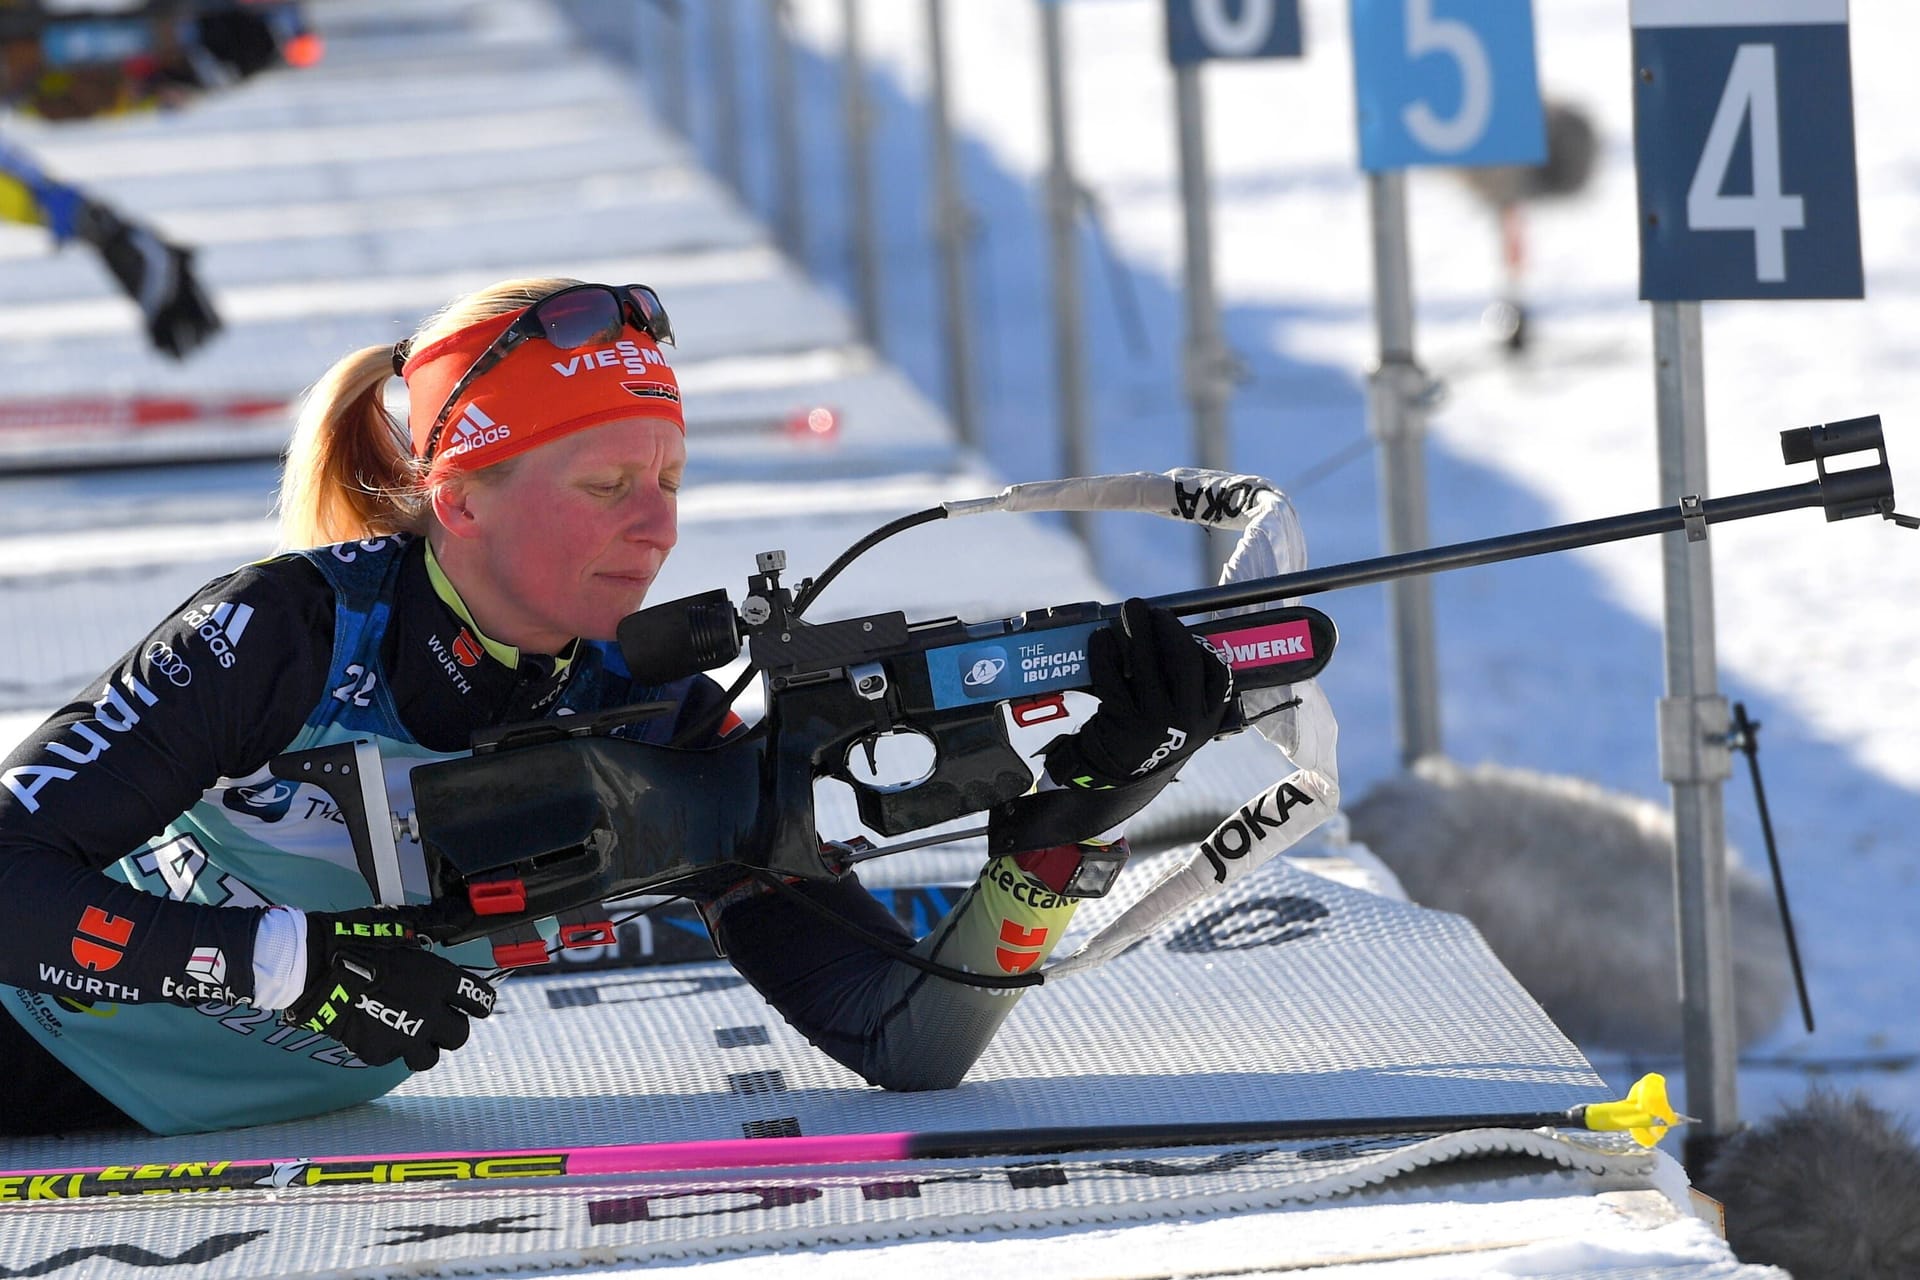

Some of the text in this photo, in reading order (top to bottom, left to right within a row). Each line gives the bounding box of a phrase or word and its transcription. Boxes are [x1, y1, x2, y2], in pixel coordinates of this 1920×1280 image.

[1403, 0, 1494, 154] 5
[1686, 43, 1805, 282] 4
[442, 424, 511, 459] adidas
[182, 609, 237, 668] adidas
[1018, 643, 1046, 658] THE
[427, 634, 473, 695] WÜRTH
[1021, 649, 1086, 671] OFFICIAL
[1023, 663, 1081, 683] IBU APP
[1200, 782, 1315, 884] JOKA
[335, 921, 403, 937] LEKI
[39, 963, 139, 1001] WÜRTH
